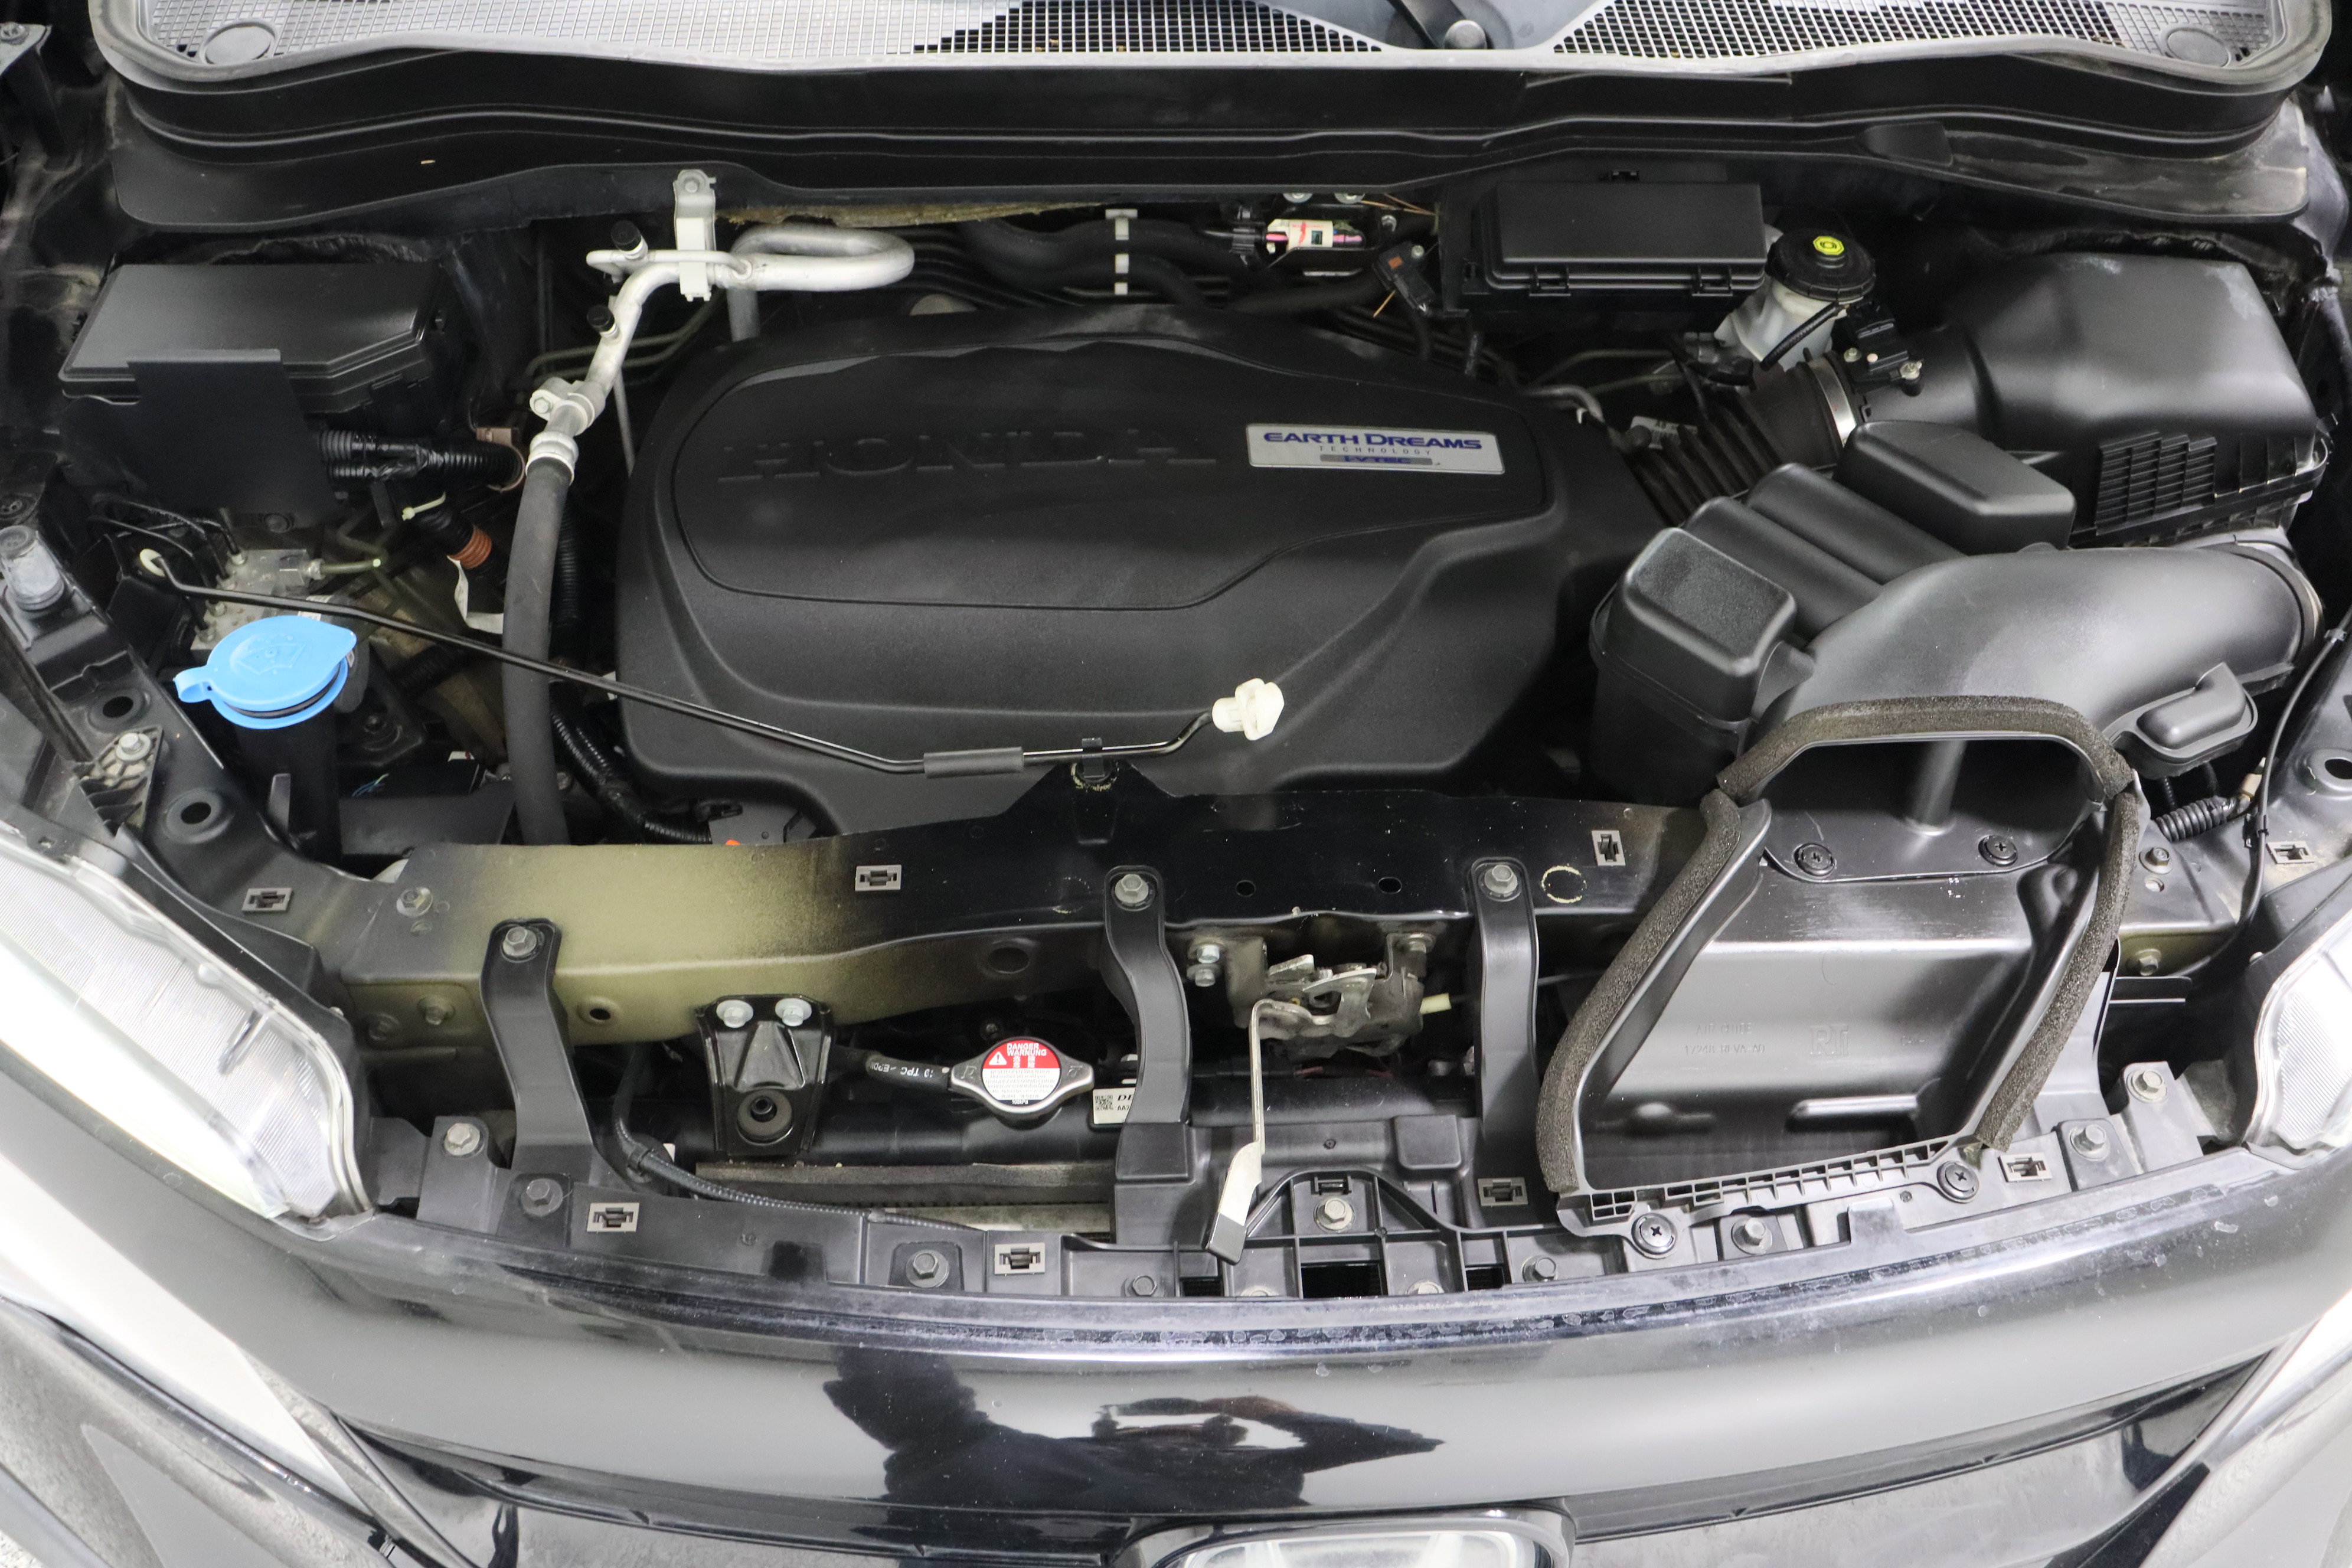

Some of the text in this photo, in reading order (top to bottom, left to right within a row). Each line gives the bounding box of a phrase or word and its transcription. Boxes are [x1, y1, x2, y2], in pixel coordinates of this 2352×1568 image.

[1263, 432, 1482, 450] EARTH DREAMS
[1319, 445, 1432, 456] TECHNOLOGY
[900, 1066, 920, 1077] TPC
